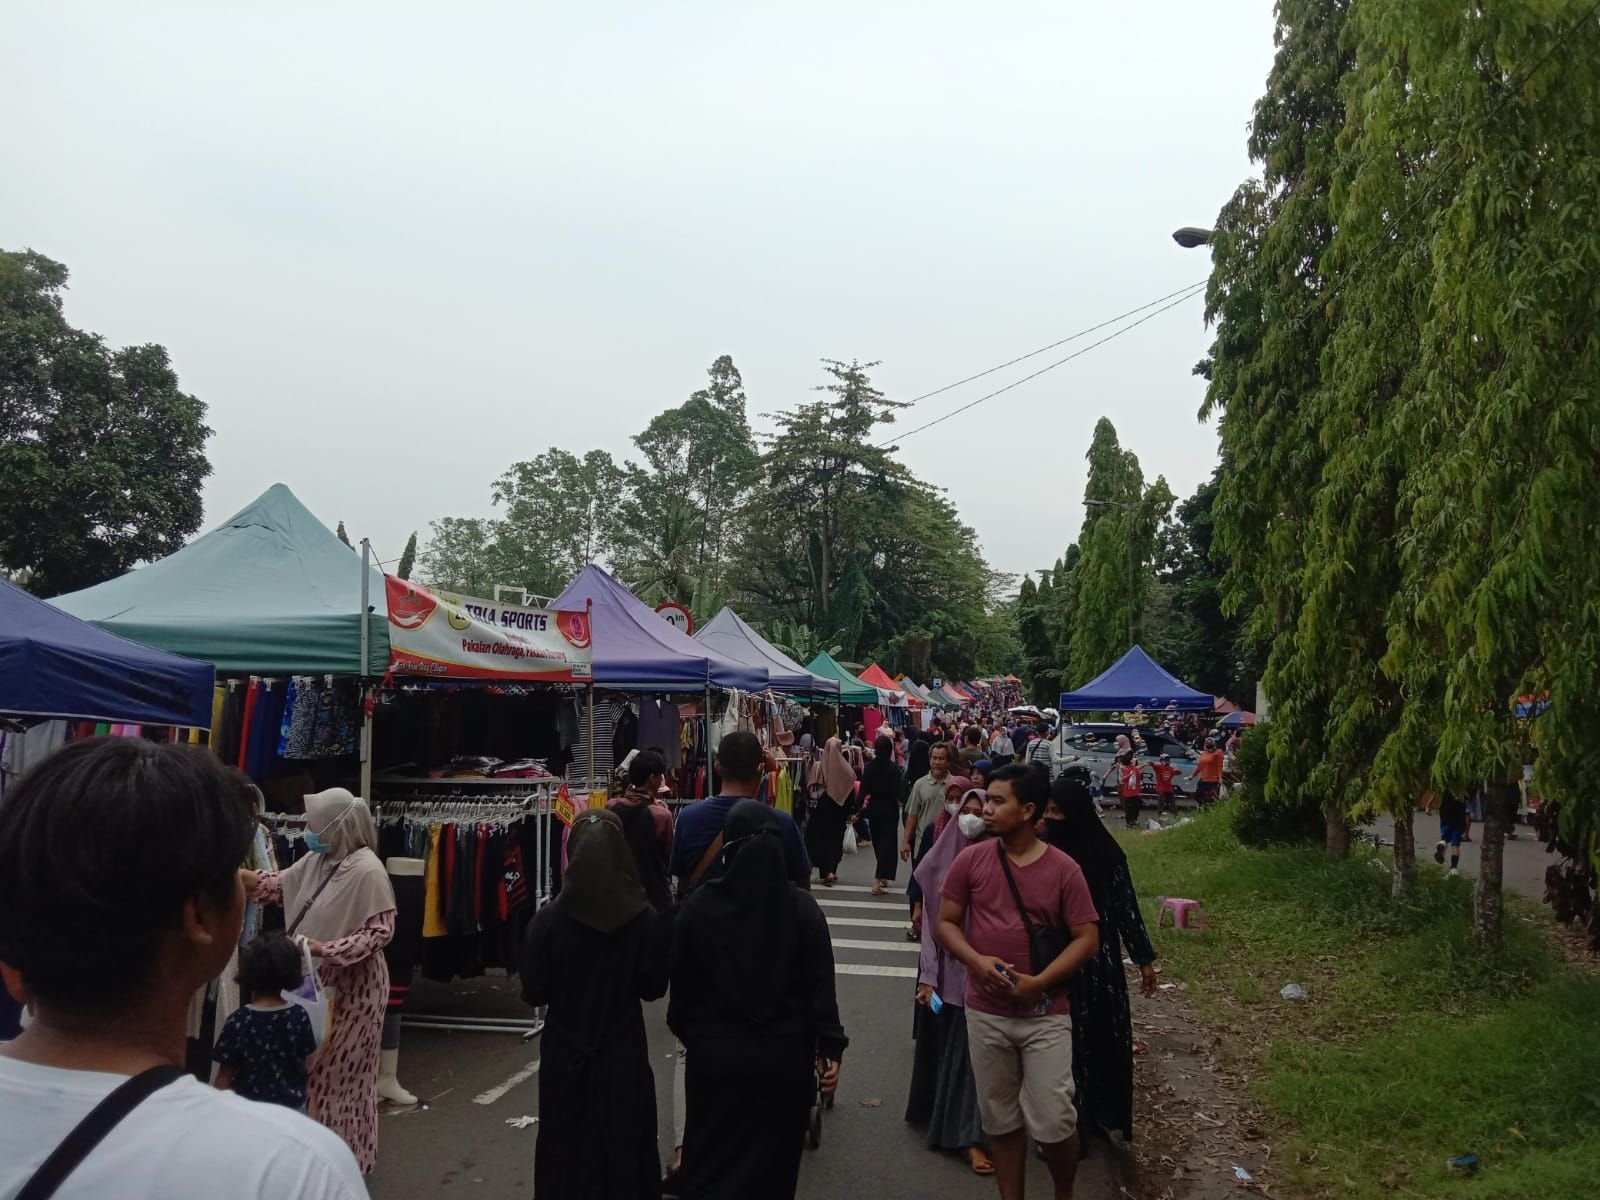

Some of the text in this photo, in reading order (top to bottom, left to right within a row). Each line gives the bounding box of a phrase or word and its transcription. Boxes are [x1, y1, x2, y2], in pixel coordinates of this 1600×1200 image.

[501, 610, 548, 631] SPORTS
[675, 614, 685, 622] km
[462, 639, 491, 654] Pakaian
[492, 640, 525, 660] Olahraga,
